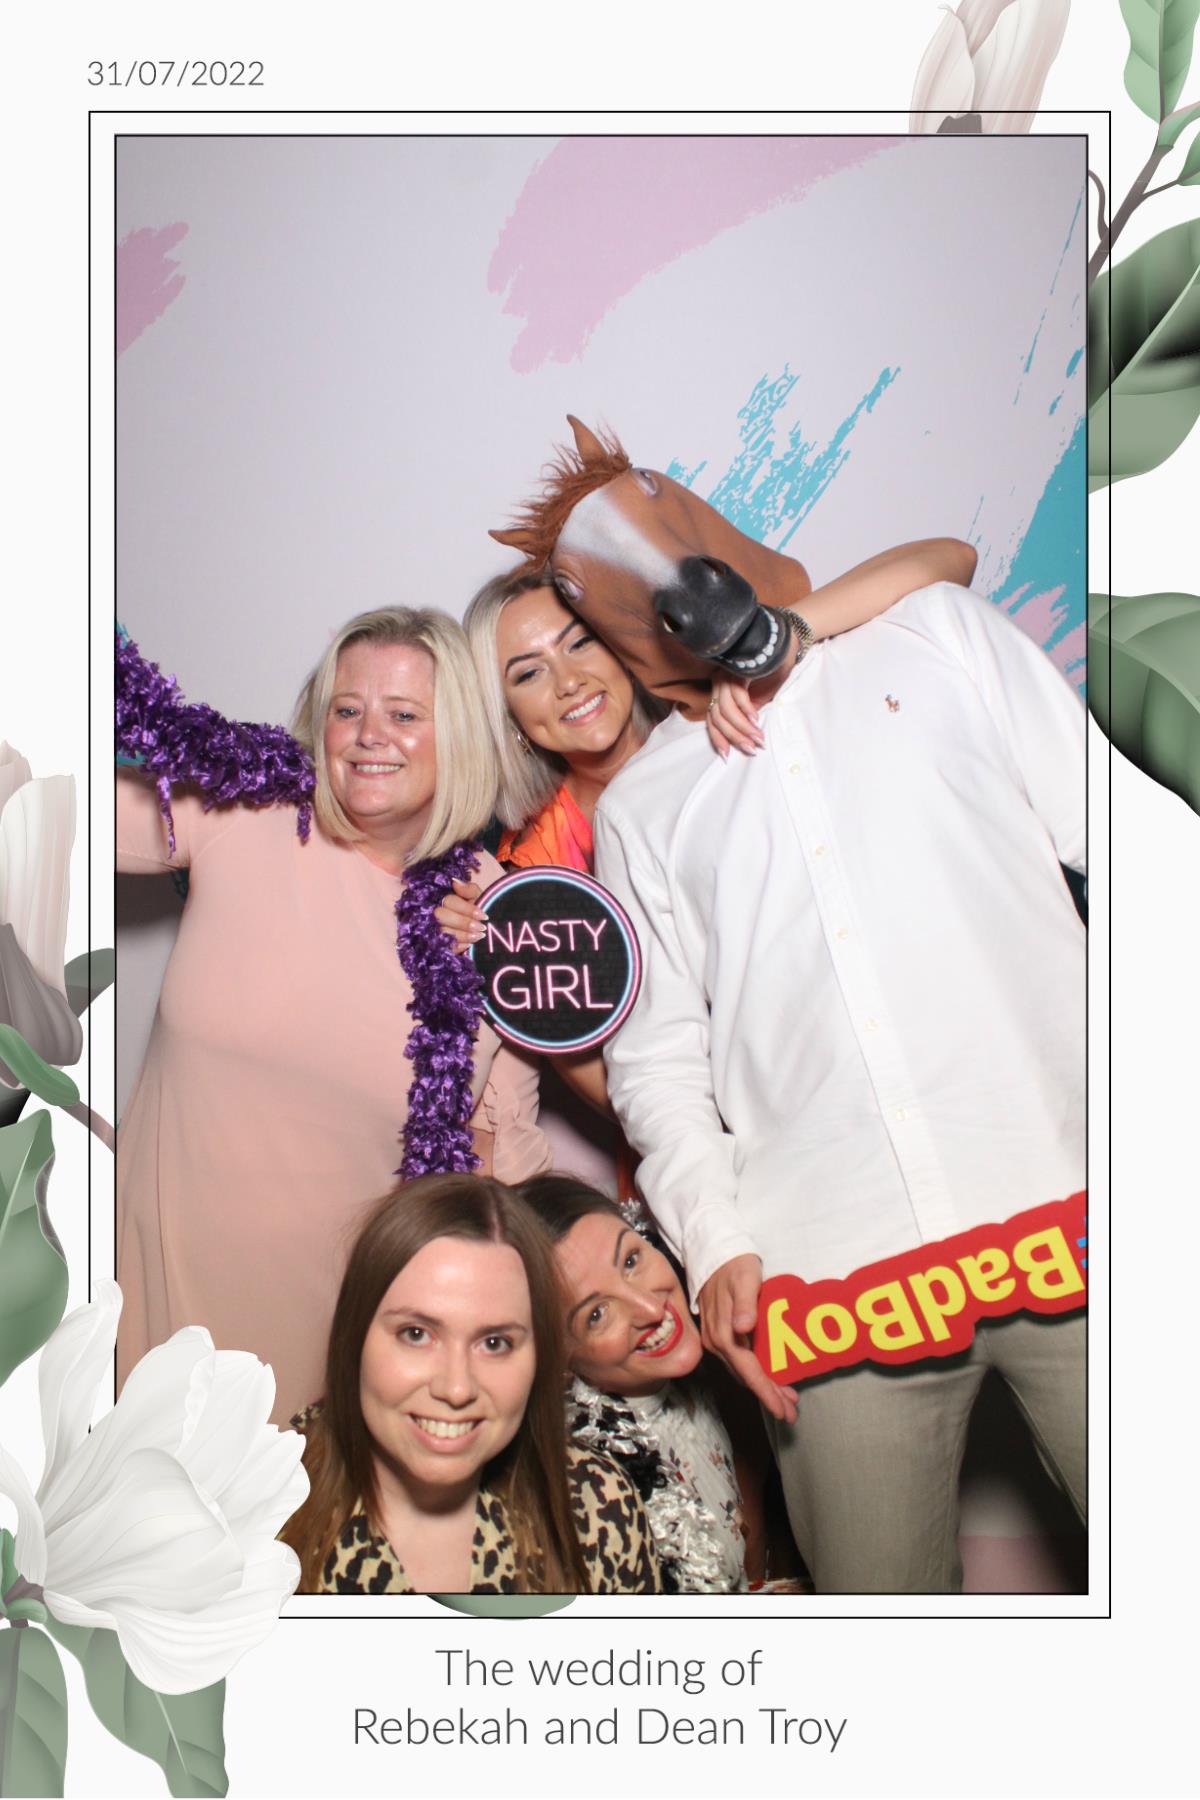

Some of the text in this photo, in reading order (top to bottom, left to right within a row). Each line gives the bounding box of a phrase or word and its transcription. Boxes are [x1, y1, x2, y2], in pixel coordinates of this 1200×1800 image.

[486, 919, 608, 953] NASTY
[492, 964, 614, 1010] GIRL
[767, 1217, 1087, 1373] BadBoy
